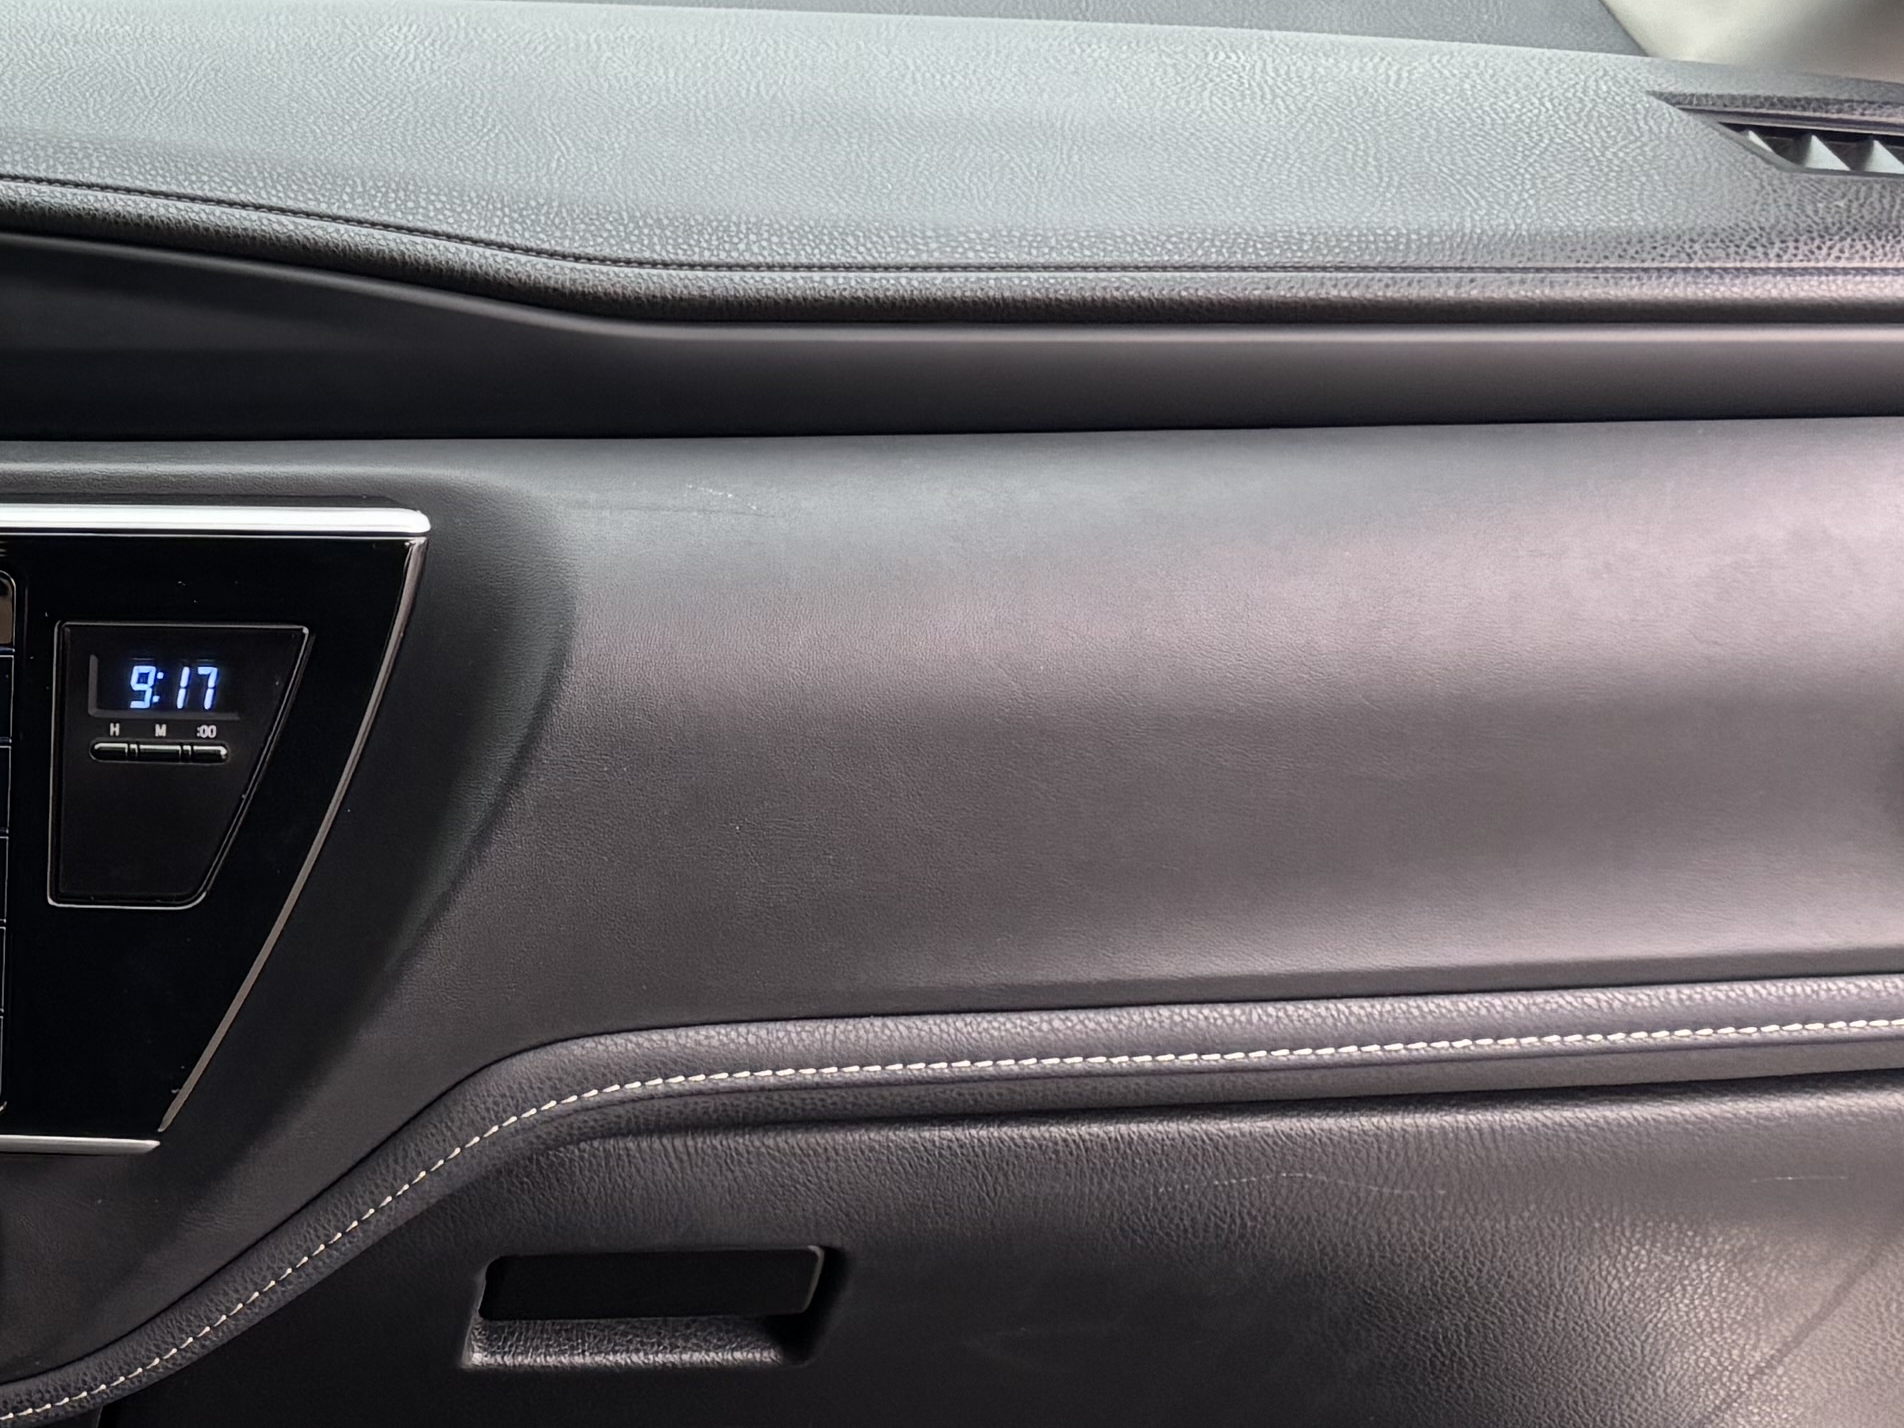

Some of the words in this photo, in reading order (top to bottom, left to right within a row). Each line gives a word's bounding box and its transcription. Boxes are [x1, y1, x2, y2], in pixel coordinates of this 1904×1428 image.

[129, 664, 219, 711] 9:17
[109, 723, 120, 737] H
[155, 724, 167, 738] M
